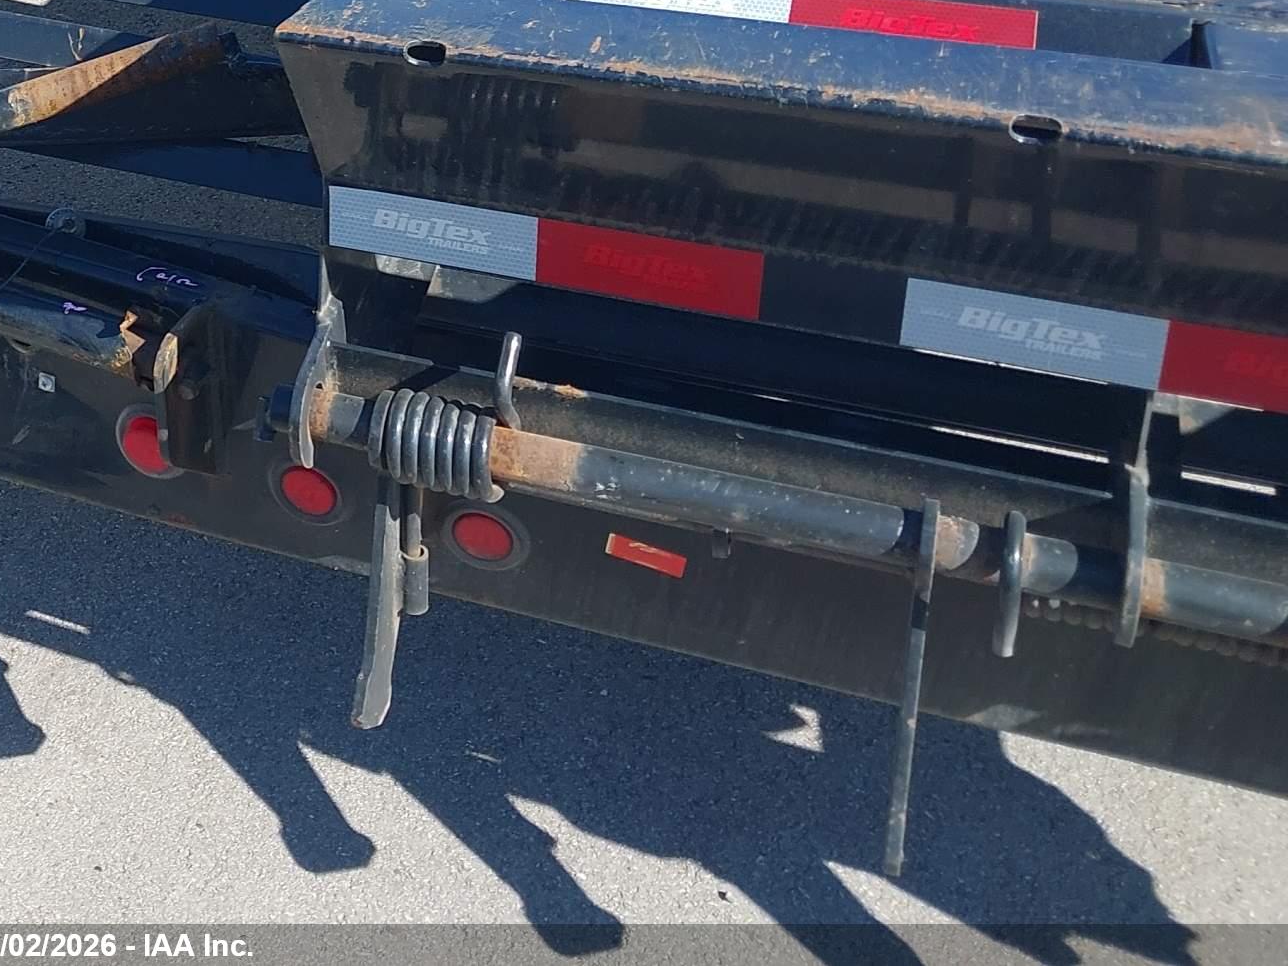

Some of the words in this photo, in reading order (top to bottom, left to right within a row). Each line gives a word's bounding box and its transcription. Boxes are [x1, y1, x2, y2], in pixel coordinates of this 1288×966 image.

[372, 208, 492, 246] BigTex
[427, 236, 489, 255] TRAILERS
[958, 305, 1107, 351] BigTex
[1023, 339, 1103, 361] TRAILERS
